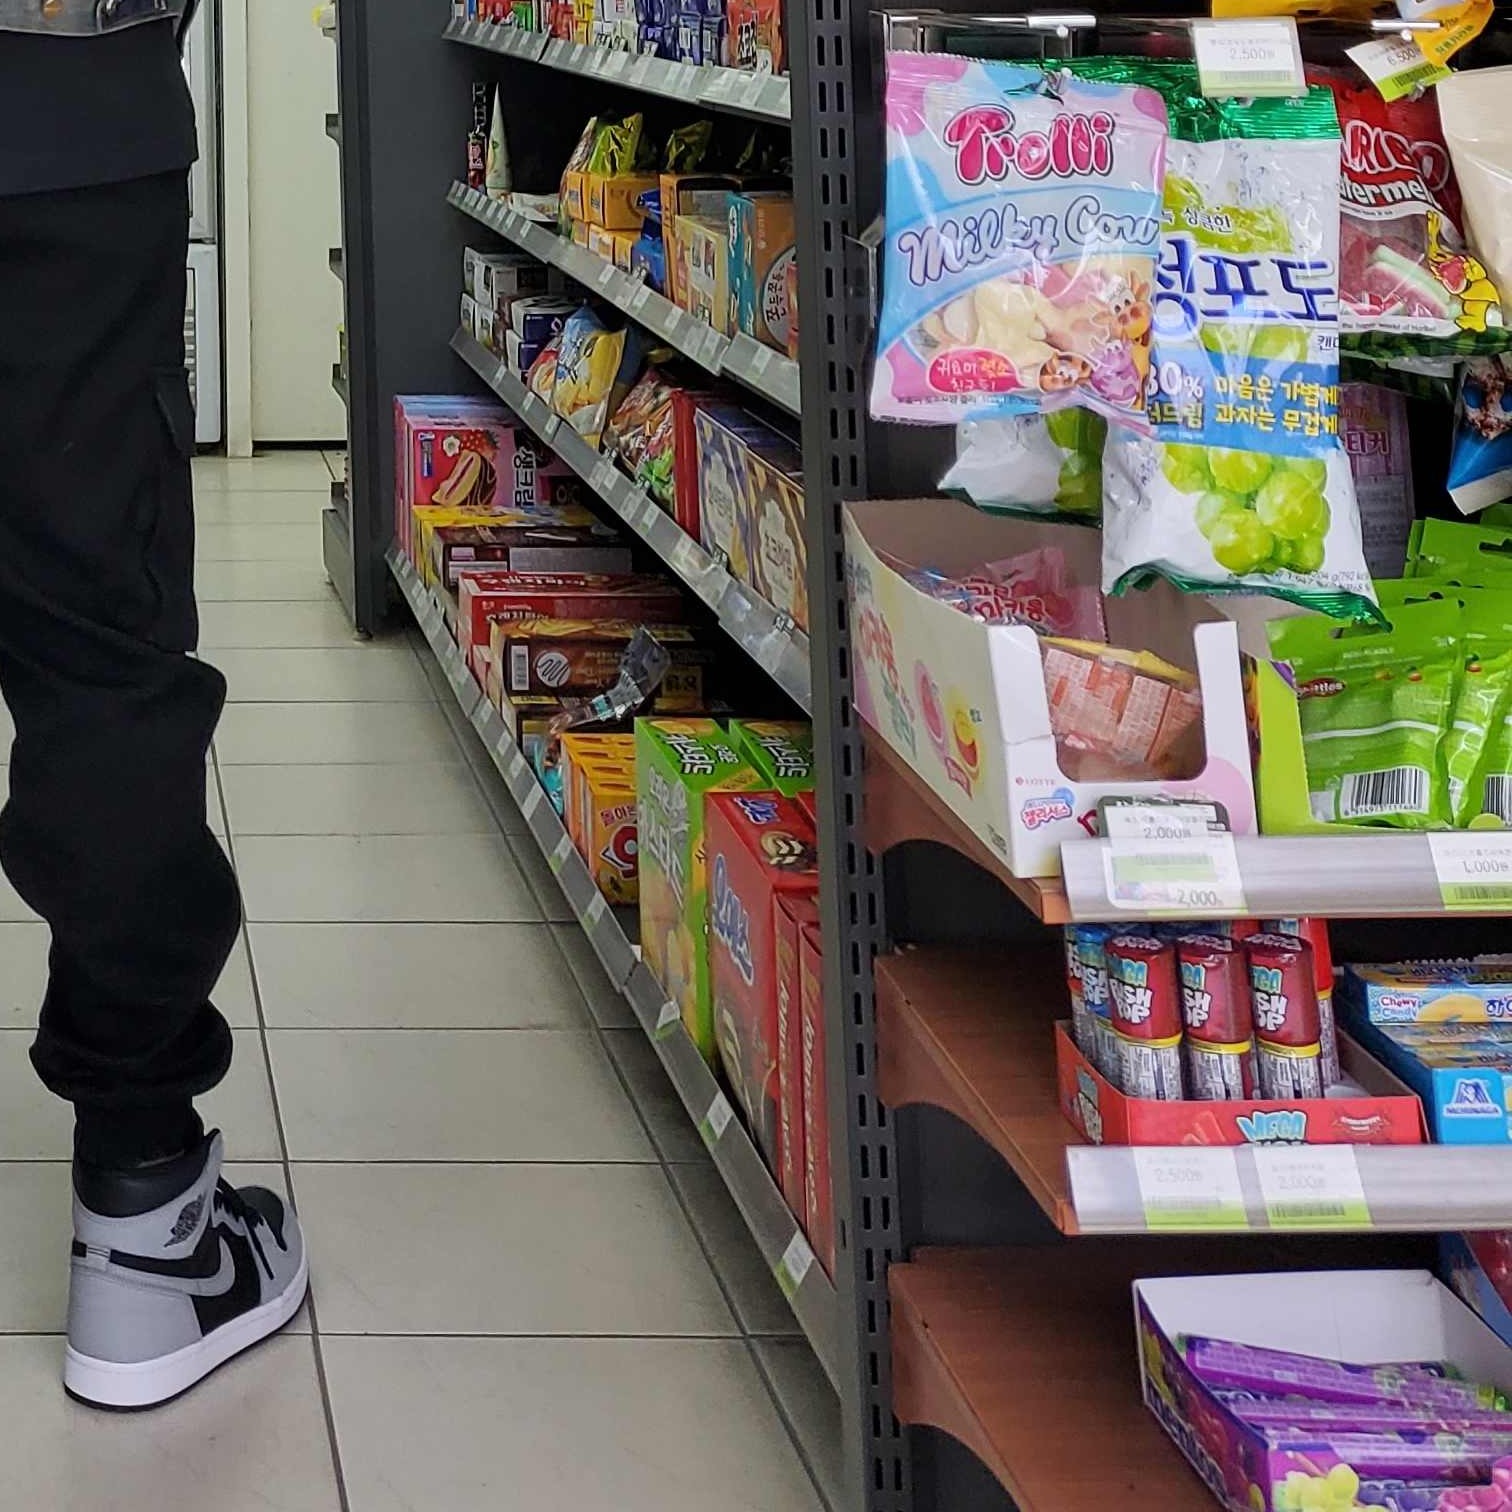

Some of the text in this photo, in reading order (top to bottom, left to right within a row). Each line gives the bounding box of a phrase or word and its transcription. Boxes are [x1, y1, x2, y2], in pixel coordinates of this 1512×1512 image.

[1229, 47, 1276, 60] 2,500원
[944, 103, 1115, 185] Trolli
[897, 194, 1161, 287] Milky Cow
[937, 358, 978, 377] 귀요미
[1215, 373, 1338, 407] 마음은 가볍게
[1214, 402, 1338, 437] 과자는 무겁게
[659, 733, 716, 776] 카스타드
[755, 735, 811, 778] 카스타드
[1025, 777, 1057, 786] LOTTE
[1143, 826, 1193, 840] 2,000원
[1177, 889, 1218, 906] 2,000
[1108, 978, 1154, 1009] PUSH
[1380, 994, 1419, 1009] Chewy
[1115, 998, 1152, 1025] POP
[1381, 1005, 1418, 1019] Candy
[1444, 1104, 1500, 1116] MORINAGA
[1236, 1110, 1308, 1141] MEGA
